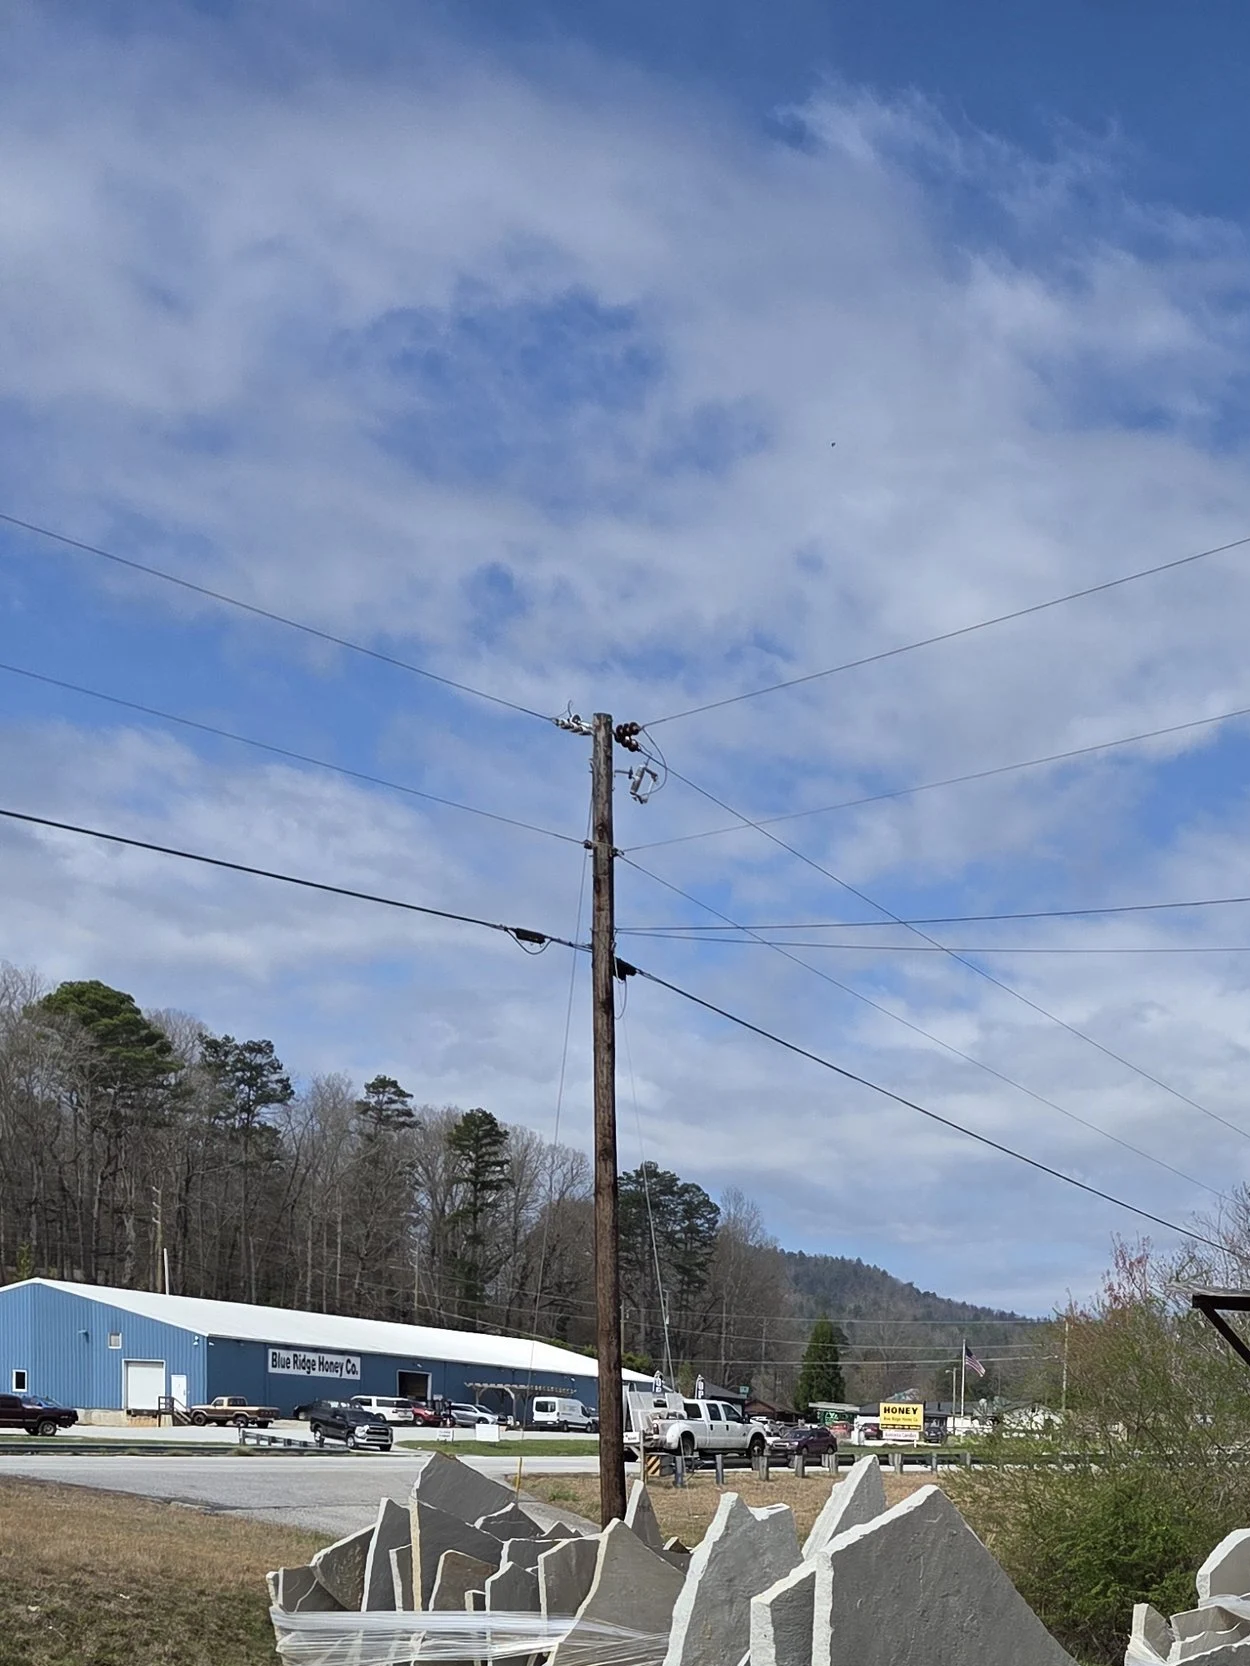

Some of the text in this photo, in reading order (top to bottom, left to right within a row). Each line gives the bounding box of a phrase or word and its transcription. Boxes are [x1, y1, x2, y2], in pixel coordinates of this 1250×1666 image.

[271, 1352, 358, 1377] Blue Ridge Honey Co.
[884, 1406, 918, 1414] HONEY
